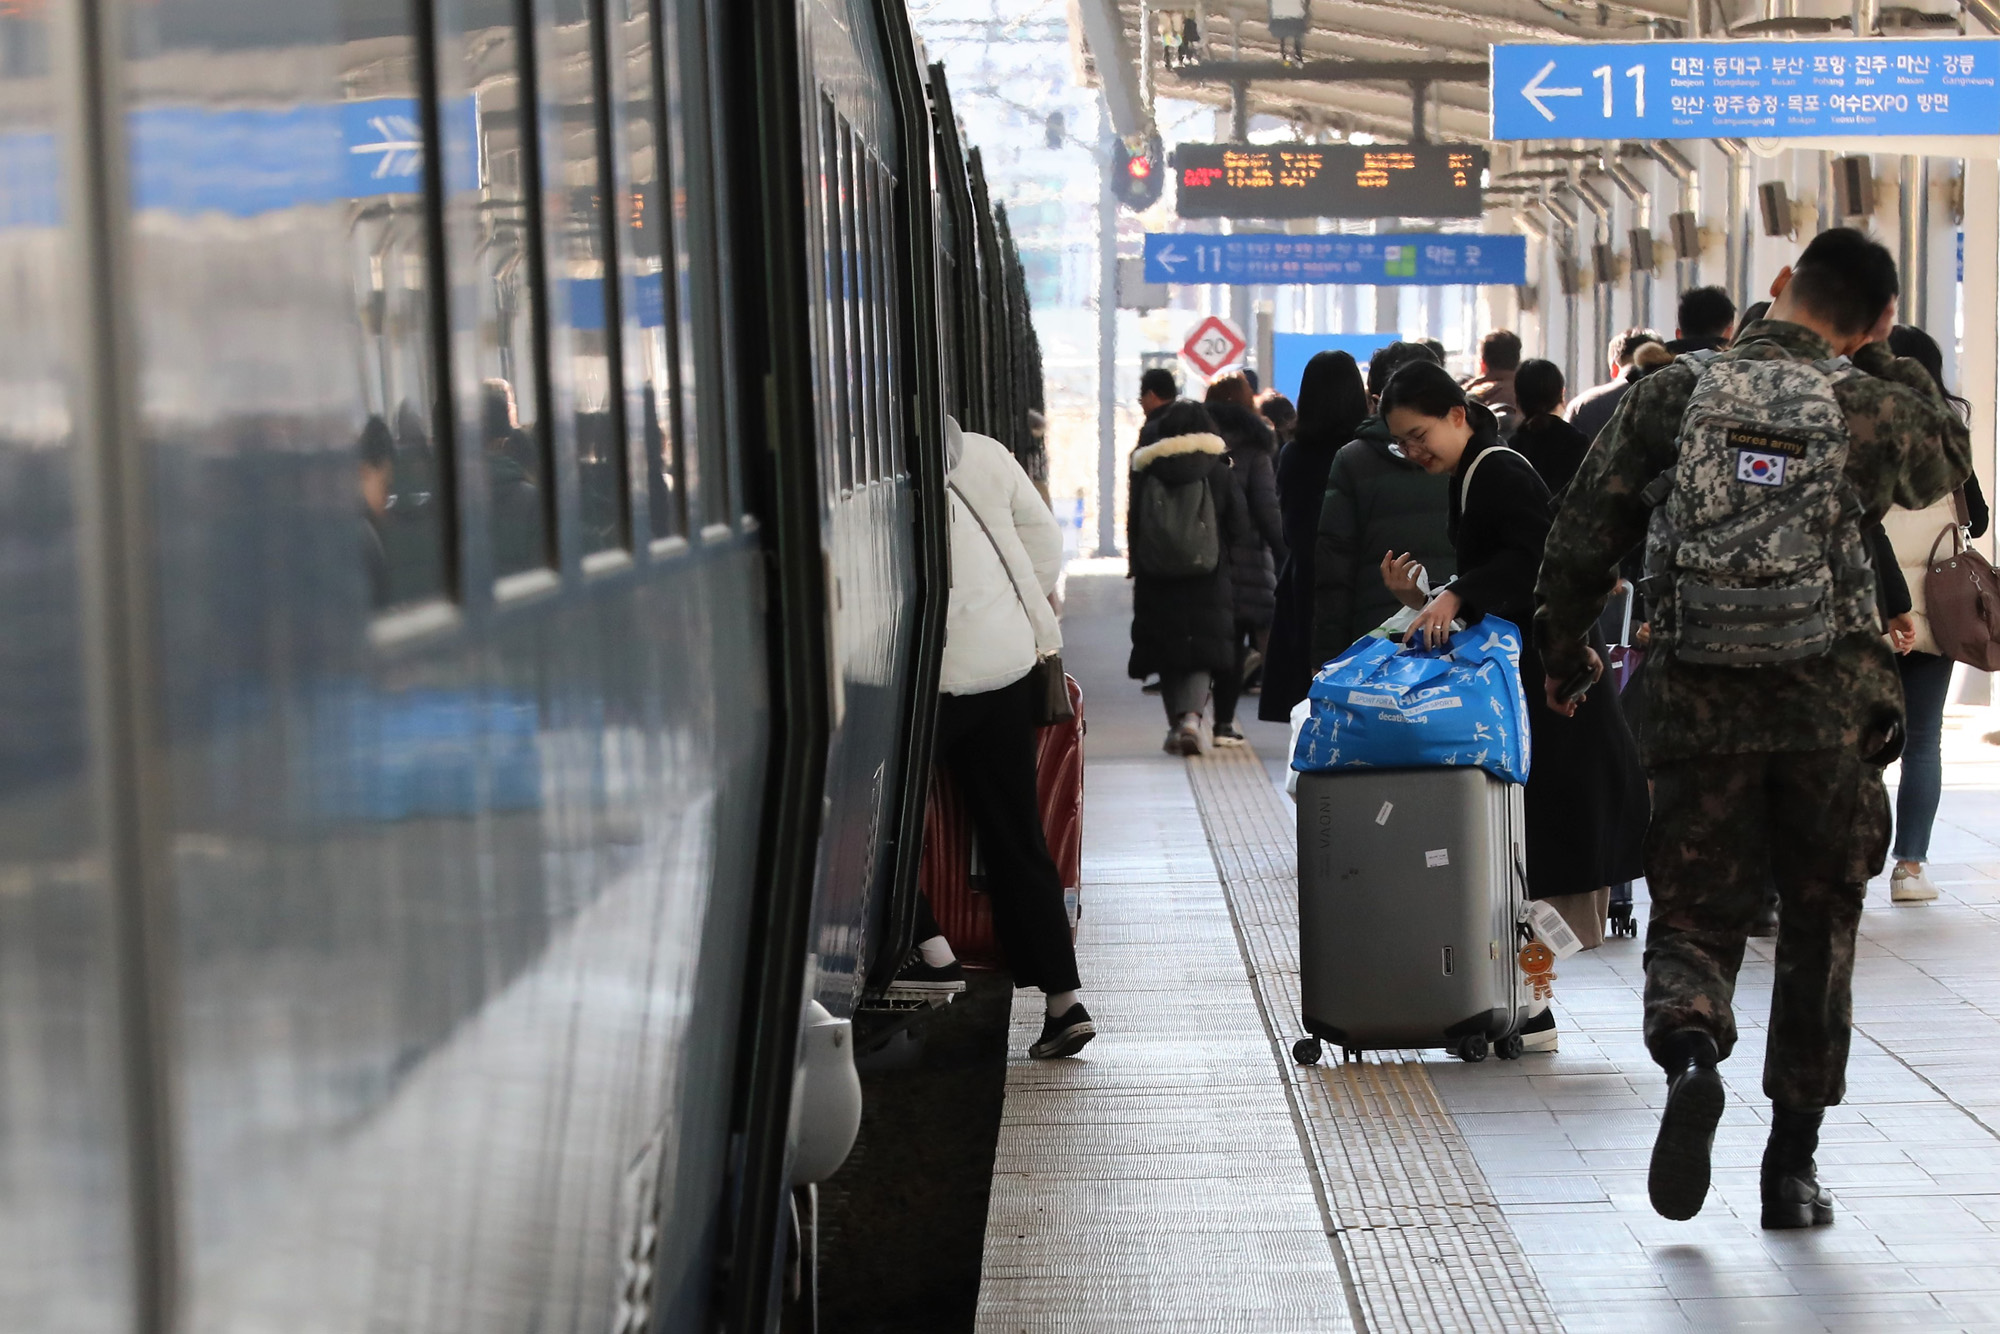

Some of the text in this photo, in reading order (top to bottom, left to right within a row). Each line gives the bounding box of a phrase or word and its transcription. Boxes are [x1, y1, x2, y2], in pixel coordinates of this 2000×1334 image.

[1671, 54, 1975, 77] 대전 동대구 부산 포항 진주 마산 강릉
[1592, 64, 1646, 118] 11
[1671, 78, 1704, 88] Daejeon
[1813, 77, 1844, 87] Pohang
[1855, 76, 1875, 87] Jinju
[1671, 93, 1949, 115] 익산 광주송정 목포 여수EXPO 방면
[1194, 244, 1222, 273] 11
[1203, 338, 1226, 356] 20
[1730, 431, 1804, 455] korea army
[1430, 699, 1454, 710] SPORT
